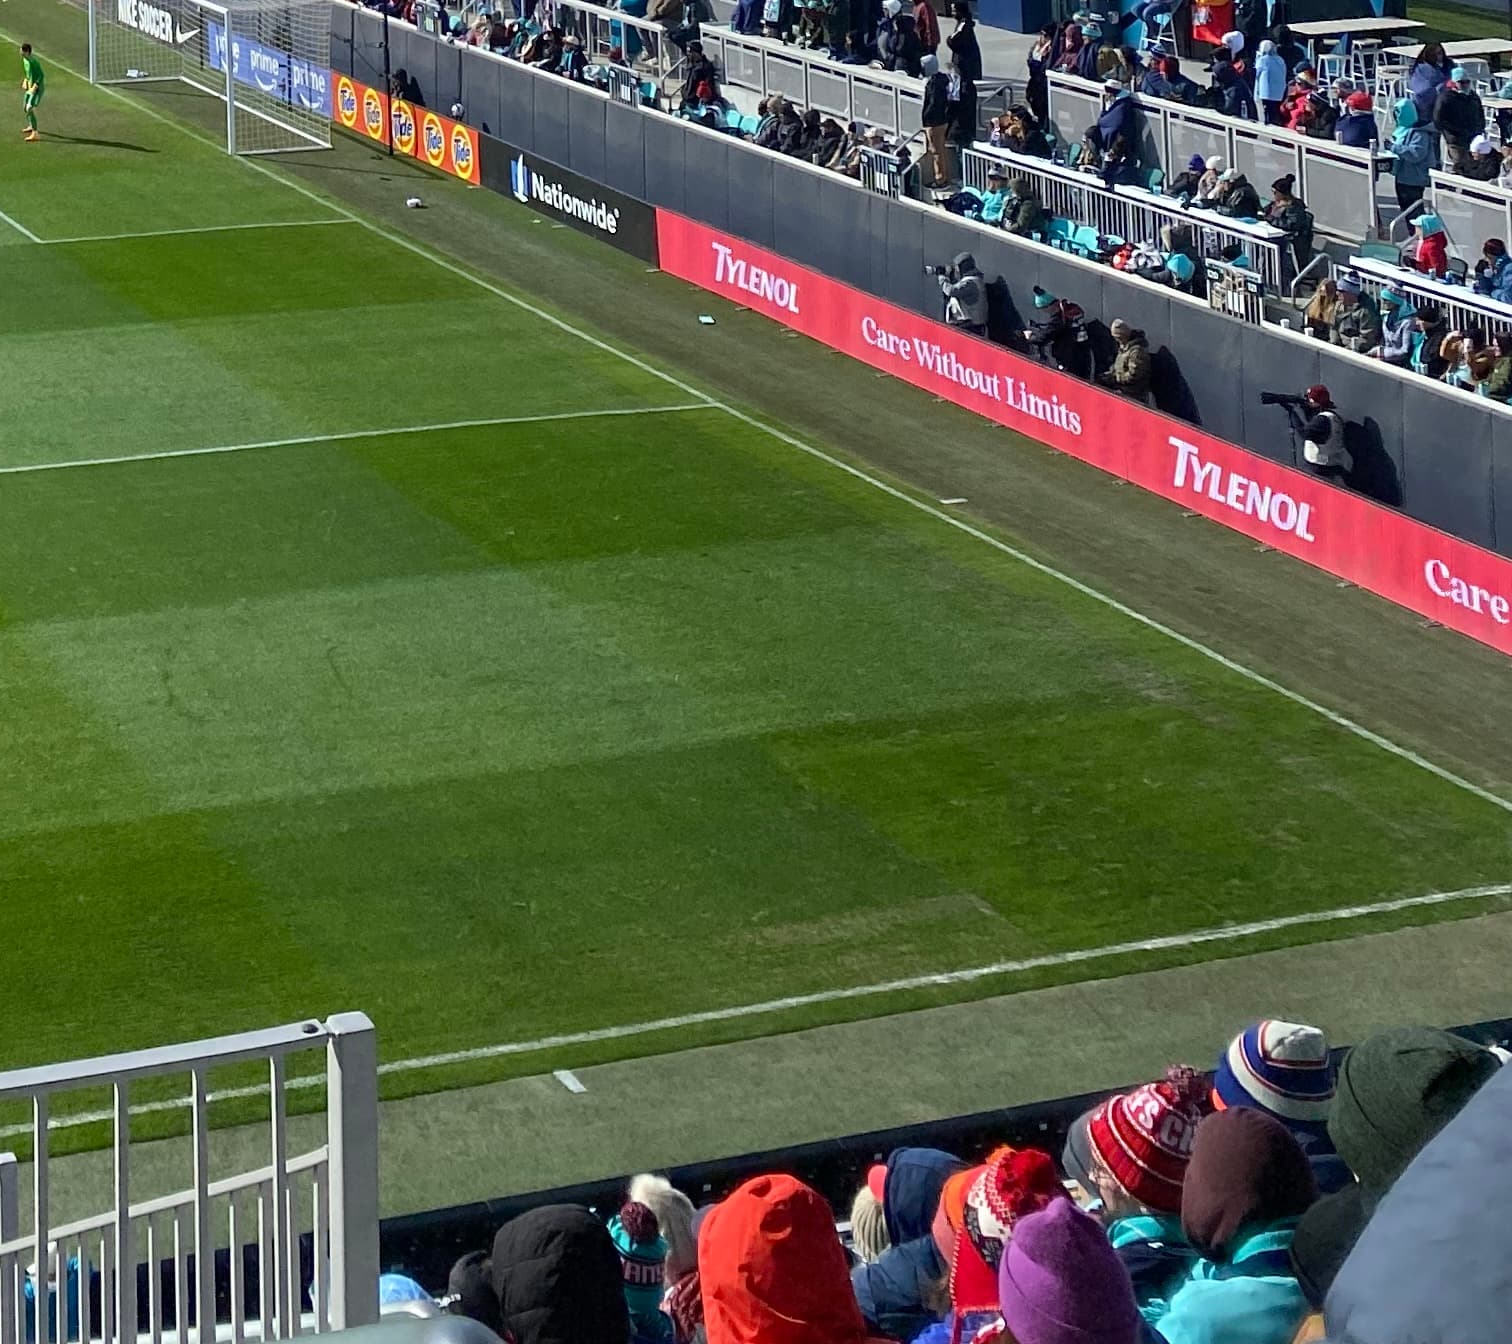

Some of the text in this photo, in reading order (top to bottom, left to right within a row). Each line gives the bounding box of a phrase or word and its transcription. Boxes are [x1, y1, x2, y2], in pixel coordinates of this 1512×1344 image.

[138, 0, 173, 44] SOCCER
[250, 47, 280, 76] prime
[340, 89, 356, 113] Tide
[393, 113, 413, 139] Tide
[425, 127, 443, 153] Tide
[453, 139, 471, 165] Tide
[531, 171, 617, 234] Nationwide
[711, 241, 800, 314] TYLENOL
[861, 316, 1082, 436] Care Without Limits
[1168, 435, 1316, 544] TYLENOL
[1424, 559, 1511, 625] Care
